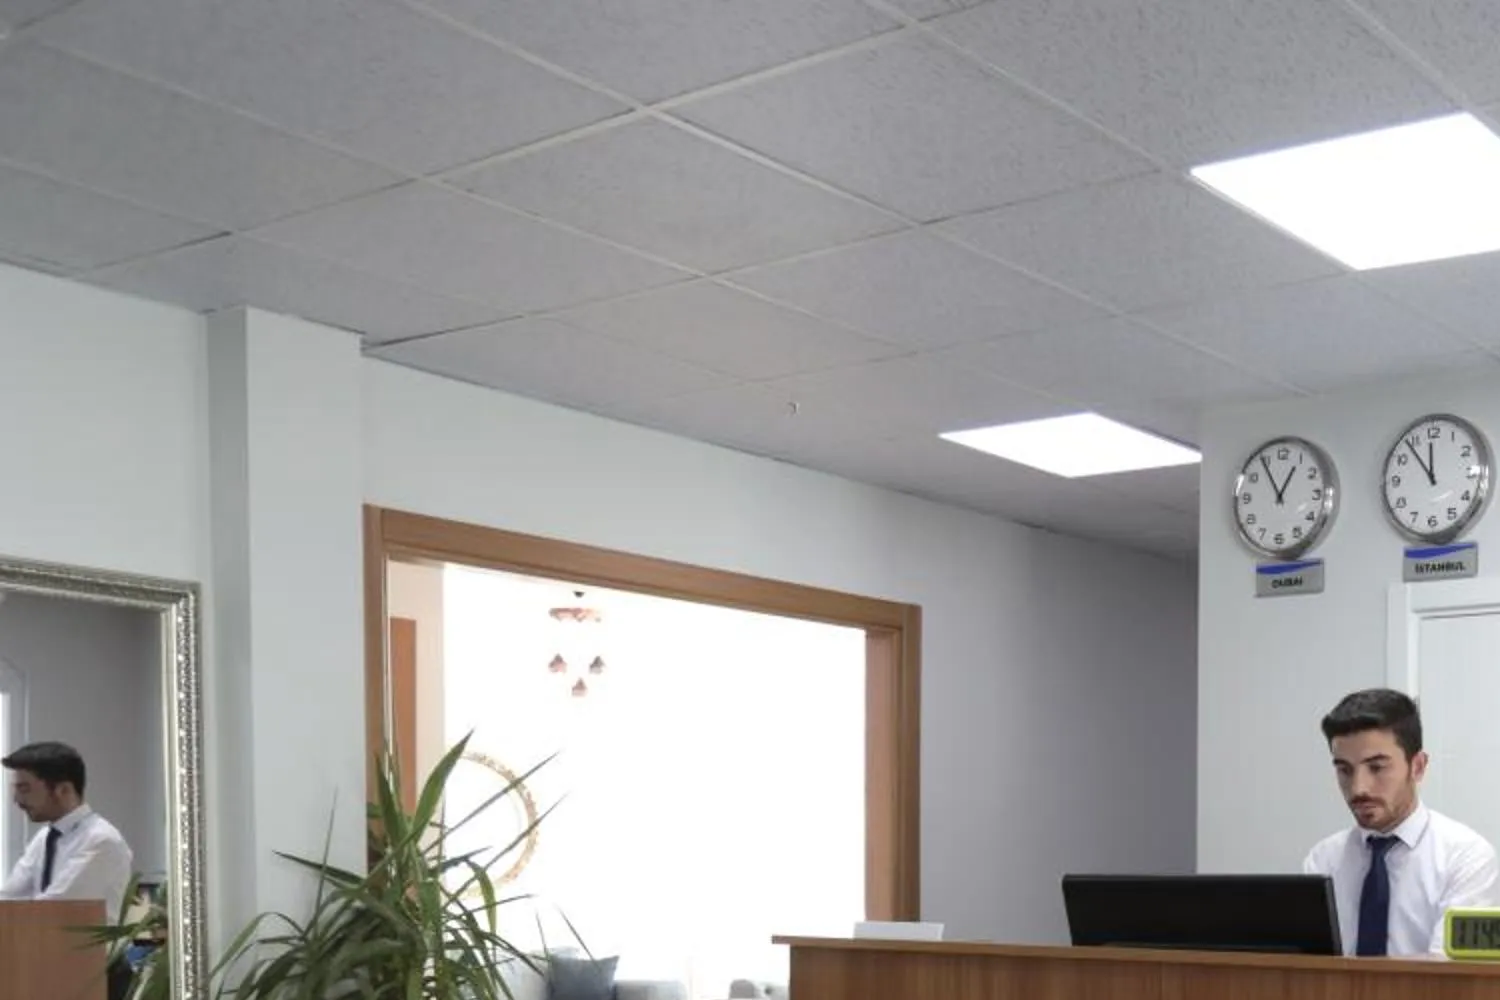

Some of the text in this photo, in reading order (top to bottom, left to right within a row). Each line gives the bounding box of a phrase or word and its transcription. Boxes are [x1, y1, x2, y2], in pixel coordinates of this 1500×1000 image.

[1427, 427, 1441, 439] 12
[1460, 445, 1471, 457] 2
[1396, 453, 1408, 466] 10
[1391, 475, 1401, 487] 9
[1460, 490, 1471, 501] 4
[1409, 511, 1419, 523] 7
[1447, 507, 1457, 520] 5
[1427, 515, 1439, 527] 6
